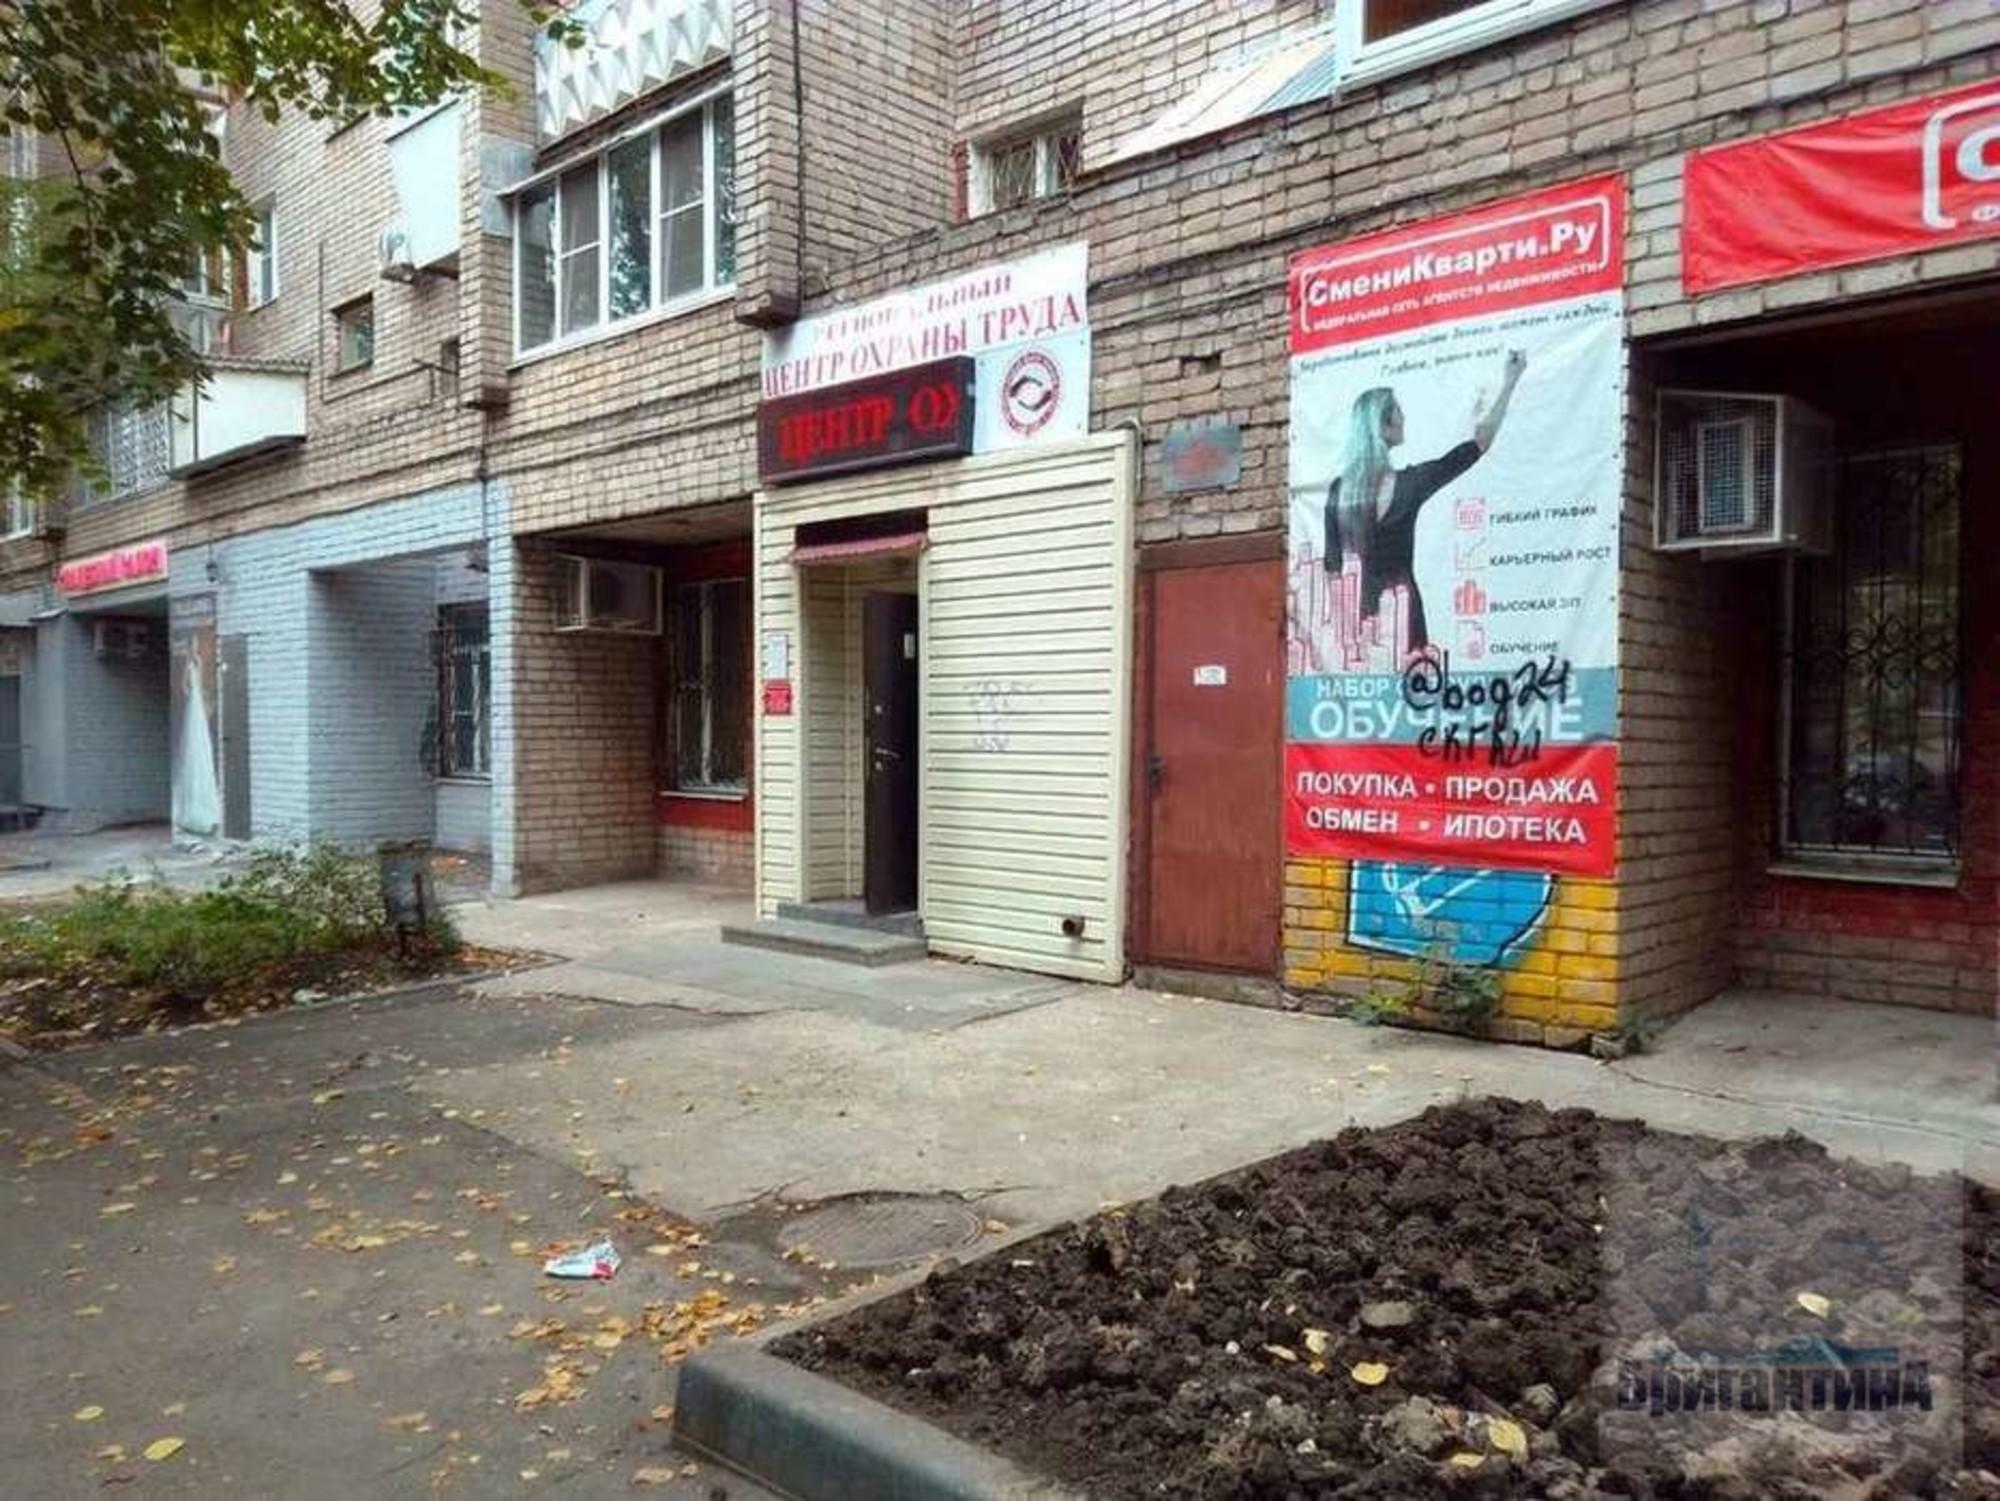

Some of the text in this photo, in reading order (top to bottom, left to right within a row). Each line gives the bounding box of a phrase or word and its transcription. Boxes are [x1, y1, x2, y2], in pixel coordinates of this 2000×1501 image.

[1308, 221, 1598, 307] СмениКварти.Ру
[764, 292, 1082, 397] ЦЕНТР ОХРАНЫ ТРУДА
[1489, 505, 1597, 526] ГИБКИЙ ГРАФИК
[1490, 546, 1612, 567] КАРЬЕРНЫЙ РОСТ
[1490, 600, 1556, 614] ВЫСОКАЯ
[1490, 640, 1560, 655] ОБУЧЕНИЕ
[1316, 677, 1390, 699] НАБОР
[1297, 771, 1599, 805] ПОКУПКА ПРОДАЖА
[1306, 807, 1587, 844] ОБМЕН ИПОТЕКА
